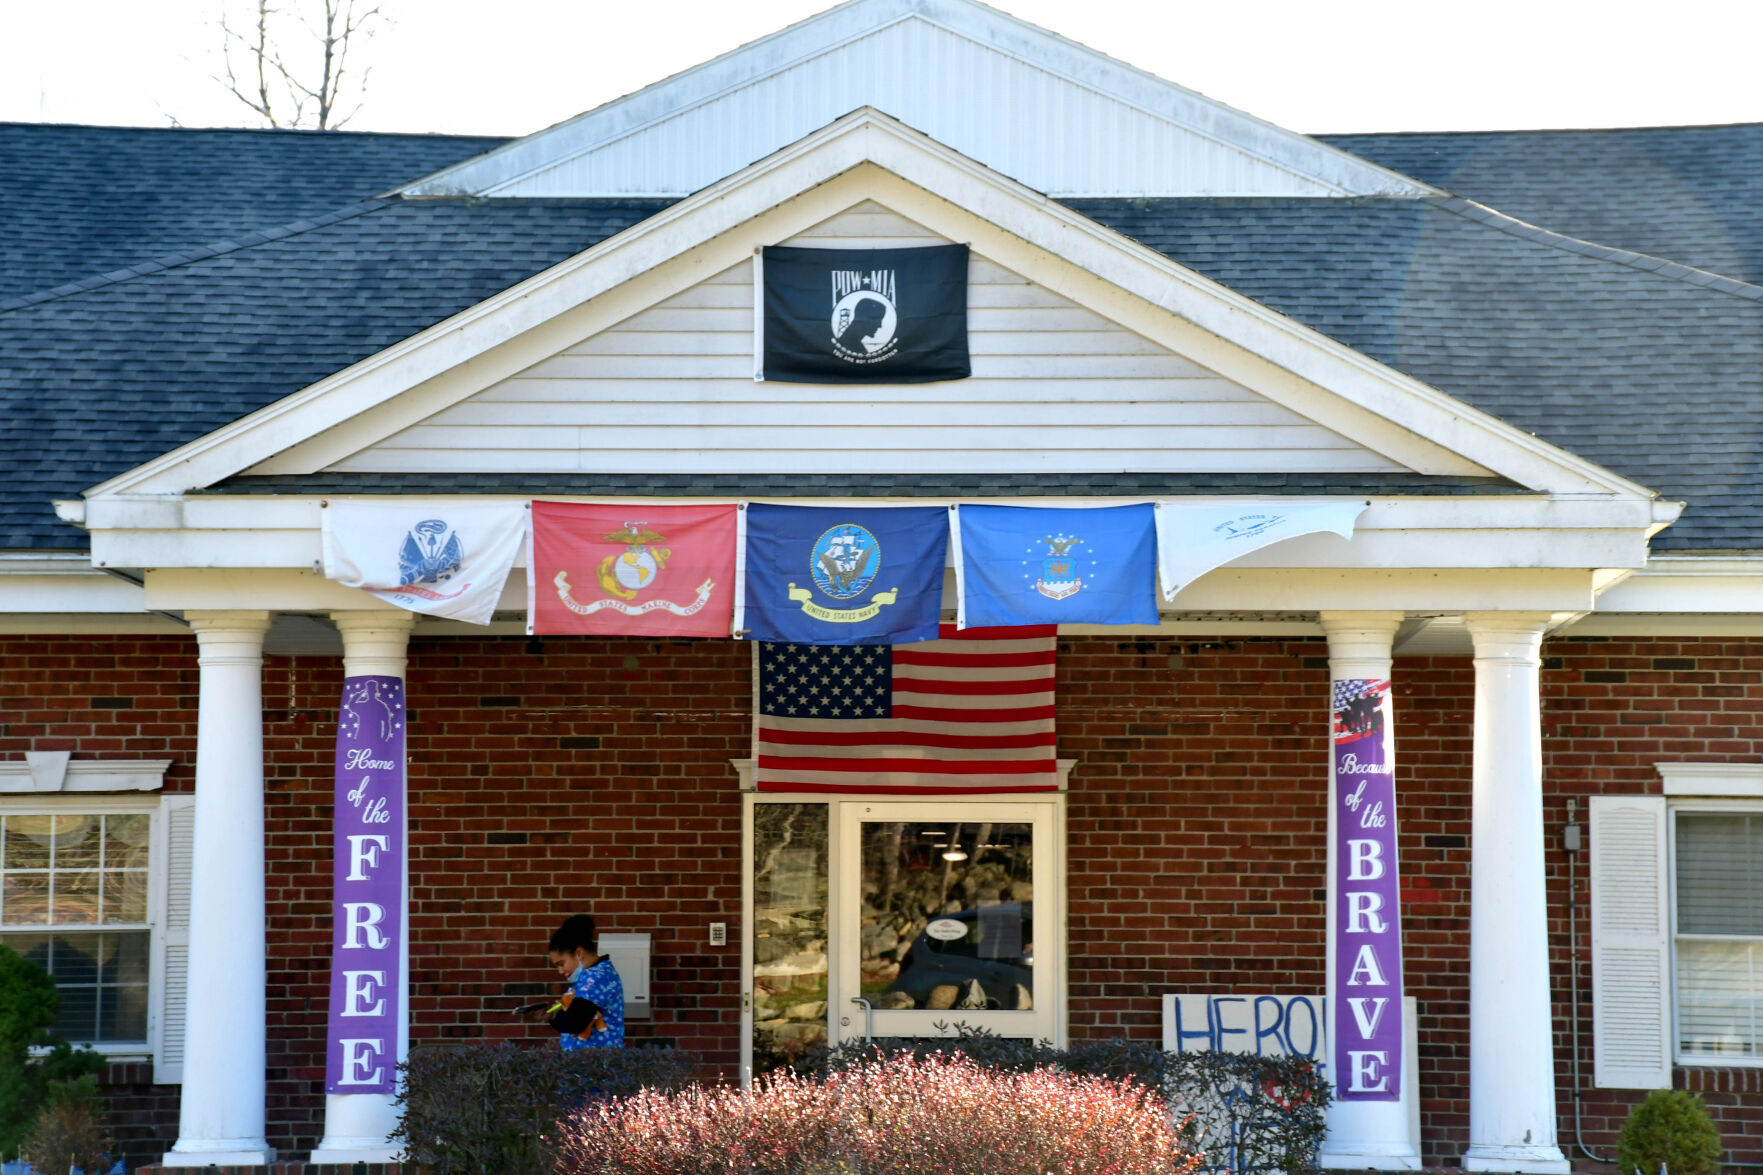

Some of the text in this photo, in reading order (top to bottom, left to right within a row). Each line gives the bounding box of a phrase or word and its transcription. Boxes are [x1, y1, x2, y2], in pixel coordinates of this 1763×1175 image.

[831, 269, 896, 309] POW MIA
[564, 595, 705, 615] UNITED STATES MARINE CORPS
[806, 603, 876, 620] UNITED STATES NAVY
[344, 748, 394, 770] Home
[347, 775, 370, 807] of
[1345, 780, 1367, 812] of
[362, 797, 390, 823] the
[1360, 801, 1387, 829] the
[337, 834, 391, 1085] FREE
[1345, 839, 1389, 1092] BRAVE
